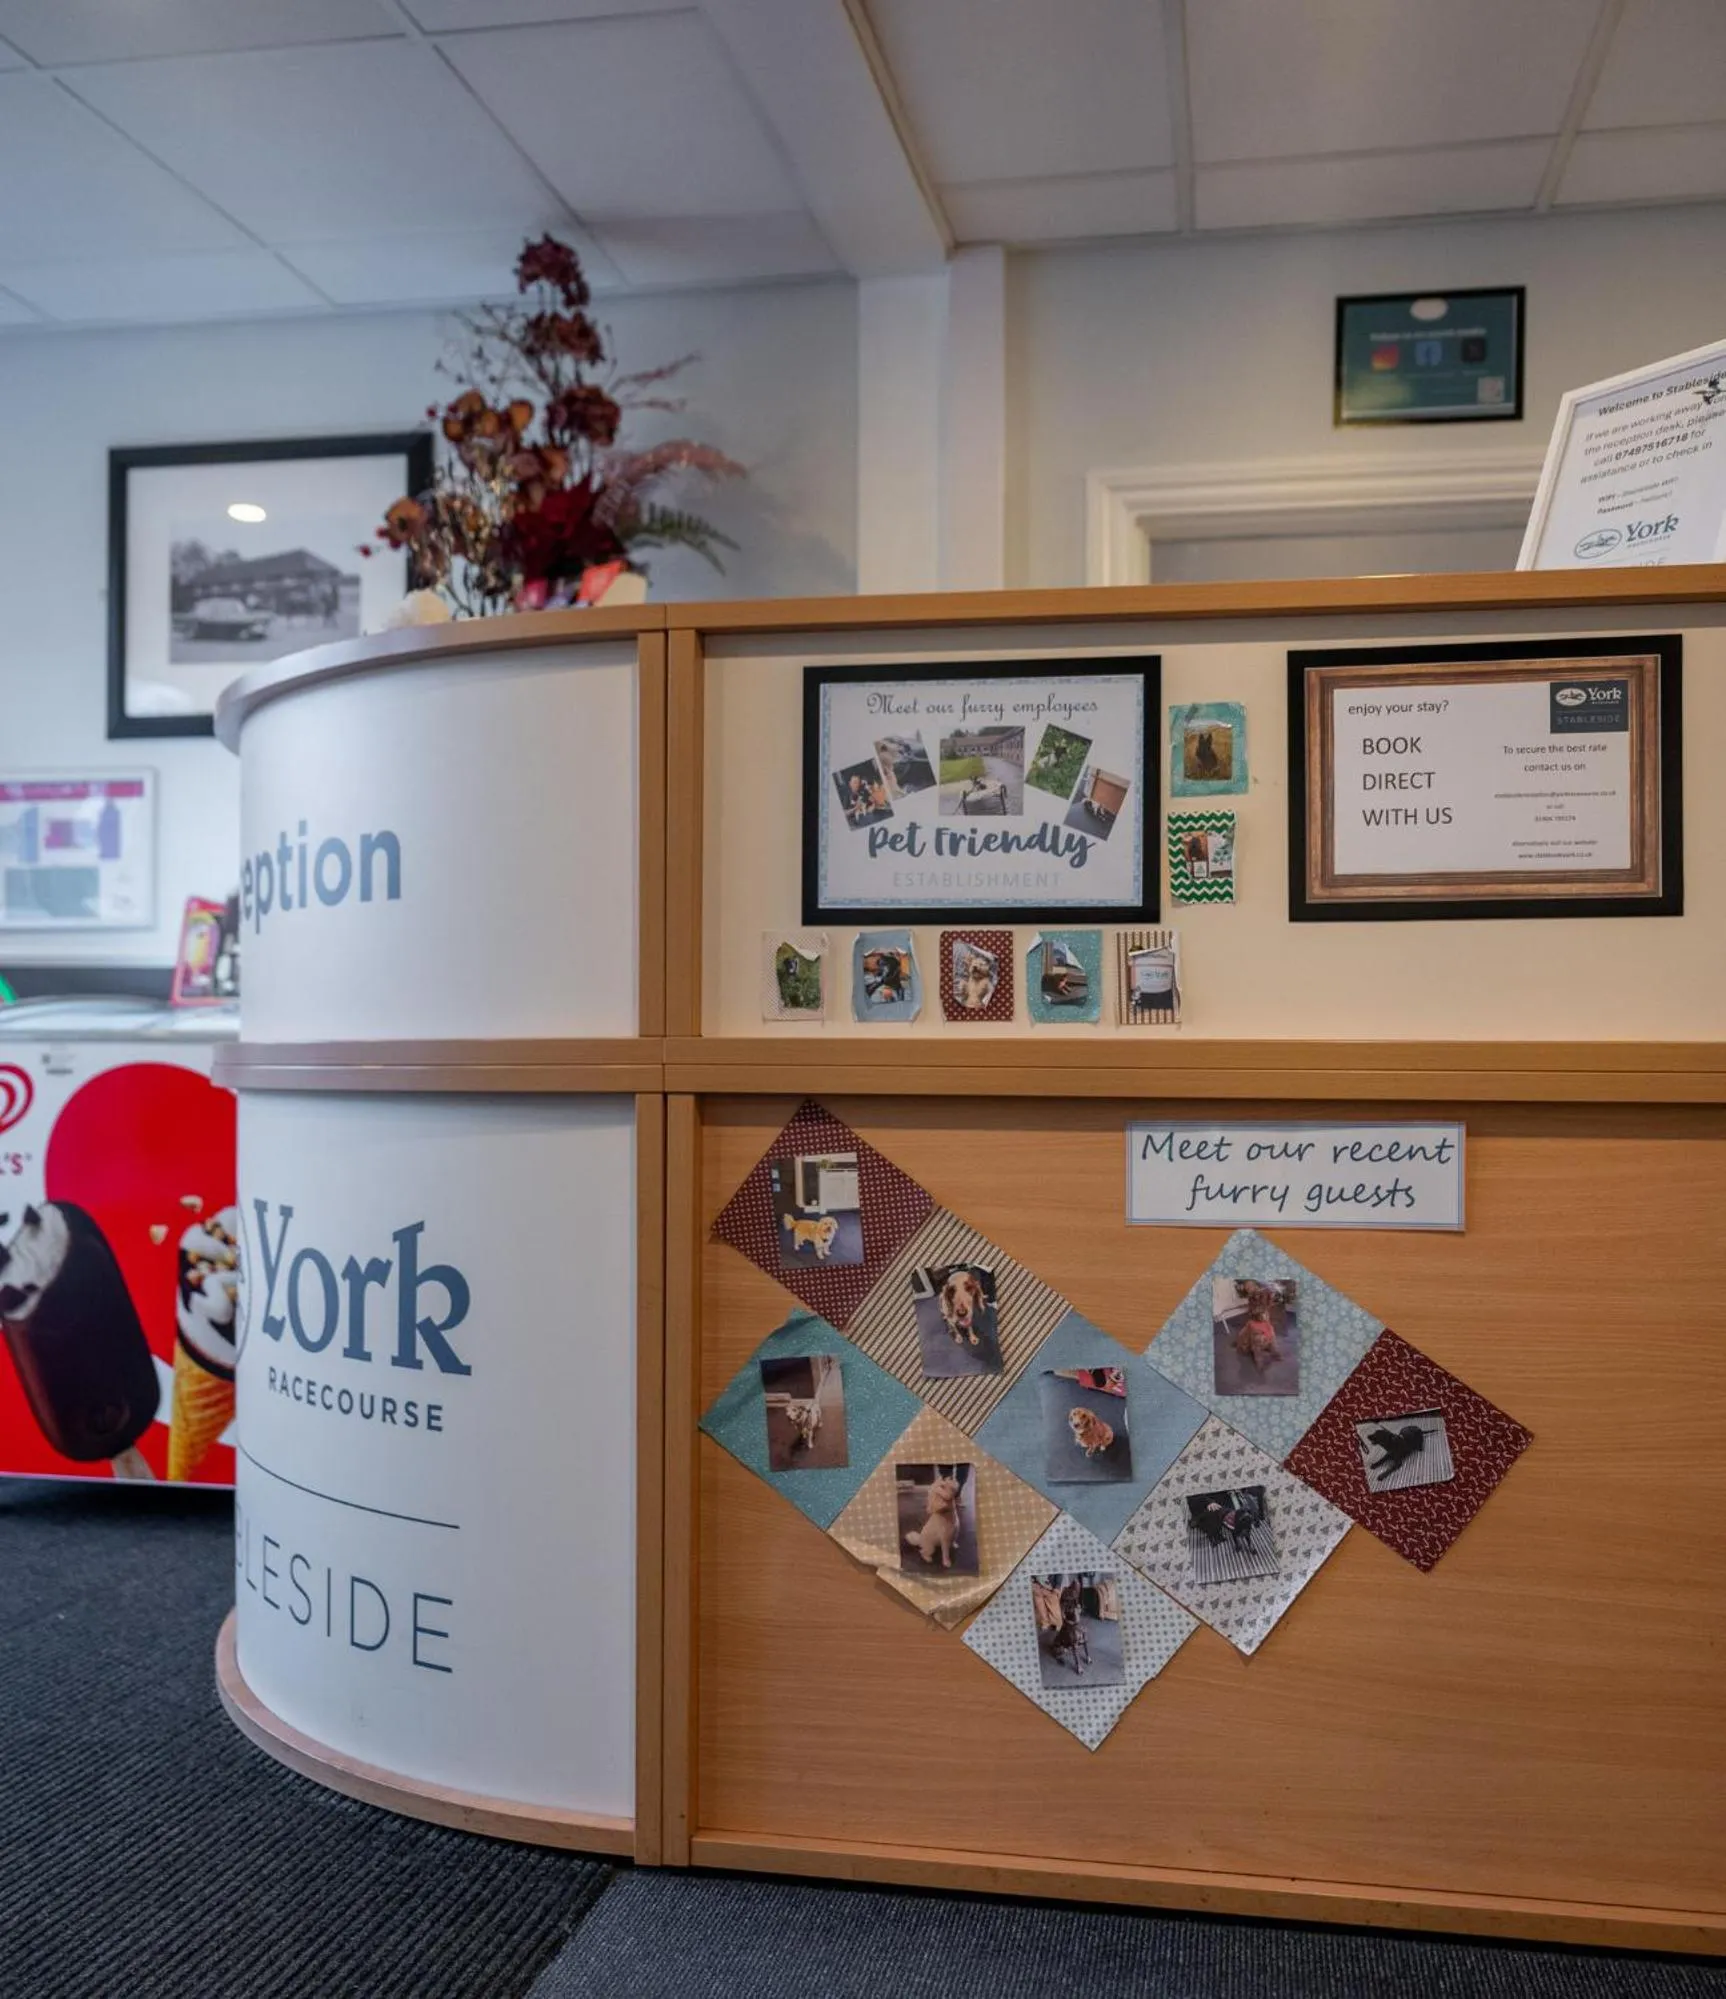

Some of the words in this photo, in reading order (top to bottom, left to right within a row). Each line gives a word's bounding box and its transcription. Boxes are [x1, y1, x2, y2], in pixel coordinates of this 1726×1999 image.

[1597, 395, 1650, 417] Welcome
[1652, 391, 1664, 401] to
[1584, 445, 1602, 457] the
[1602, 429, 1654, 452] reception
[1655, 421, 1685, 437] desk,
[1686, 409, 1726, 429] please
[1594, 429, 1610, 440] we
[1611, 424, 1629, 436] are
[1630, 411, 1672, 429] working
[1674, 401, 1703, 417] away
[1580, 461, 1637, 484] assistance
[1638, 458, 1651, 468] or
[1652, 454, 1664, 464] to
[1666, 444, 1699, 461] check
[1701, 441, 1713, 451] in
[1593, 455, 1613, 467] call
[1690, 428, 1706, 440] for
[1626, 513, 1680, 543] York
[865, 691, 919, 716] Meet
[926, 701, 955, 716] our
[958, 695, 1005, 722] furry
[1012, 693, 1099, 722] employees
[1348, 702, 1382, 716] enjoy
[1385, 702, 1413, 715] your
[1417, 700, 1449, 715] stay?
[1587, 687, 1622, 701] York
[1361, 735, 1422, 756] BOOK
[1503, 745, 1514, 755] To
[1515, 745, 1547, 754] secure
[1548, 744, 1564, 754] the
[1566, 744, 1586, 753] best
[1588, 743, 1607, 753] rate
[1361, 771, 1436, 791] DIRECT
[1524, 763, 1558, 772] contact
[1561, 763, 1572, 772] us
[1574, 763, 1586, 772] on
[1361, 807, 1418, 827] WITH
[1425, 806, 1453, 825] US
[867, 822, 927, 859] Pet
[934, 821, 1098, 869] Friendly
[239, 820, 402, 934] eption
[893, 871, 1064, 889] ESTABLISHMENT
[1141, 1131, 1232, 1163] Meet
[1245, 1140, 1315, 1163] our
[1332, 1137, 1455, 1165] recent
[1185, 1174, 1290, 1212] furry
[1303, 1177, 1417, 1212] guests
[252, 1198, 473, 1376] York
[268, 1365, 444, 1433] RACECOURSE
